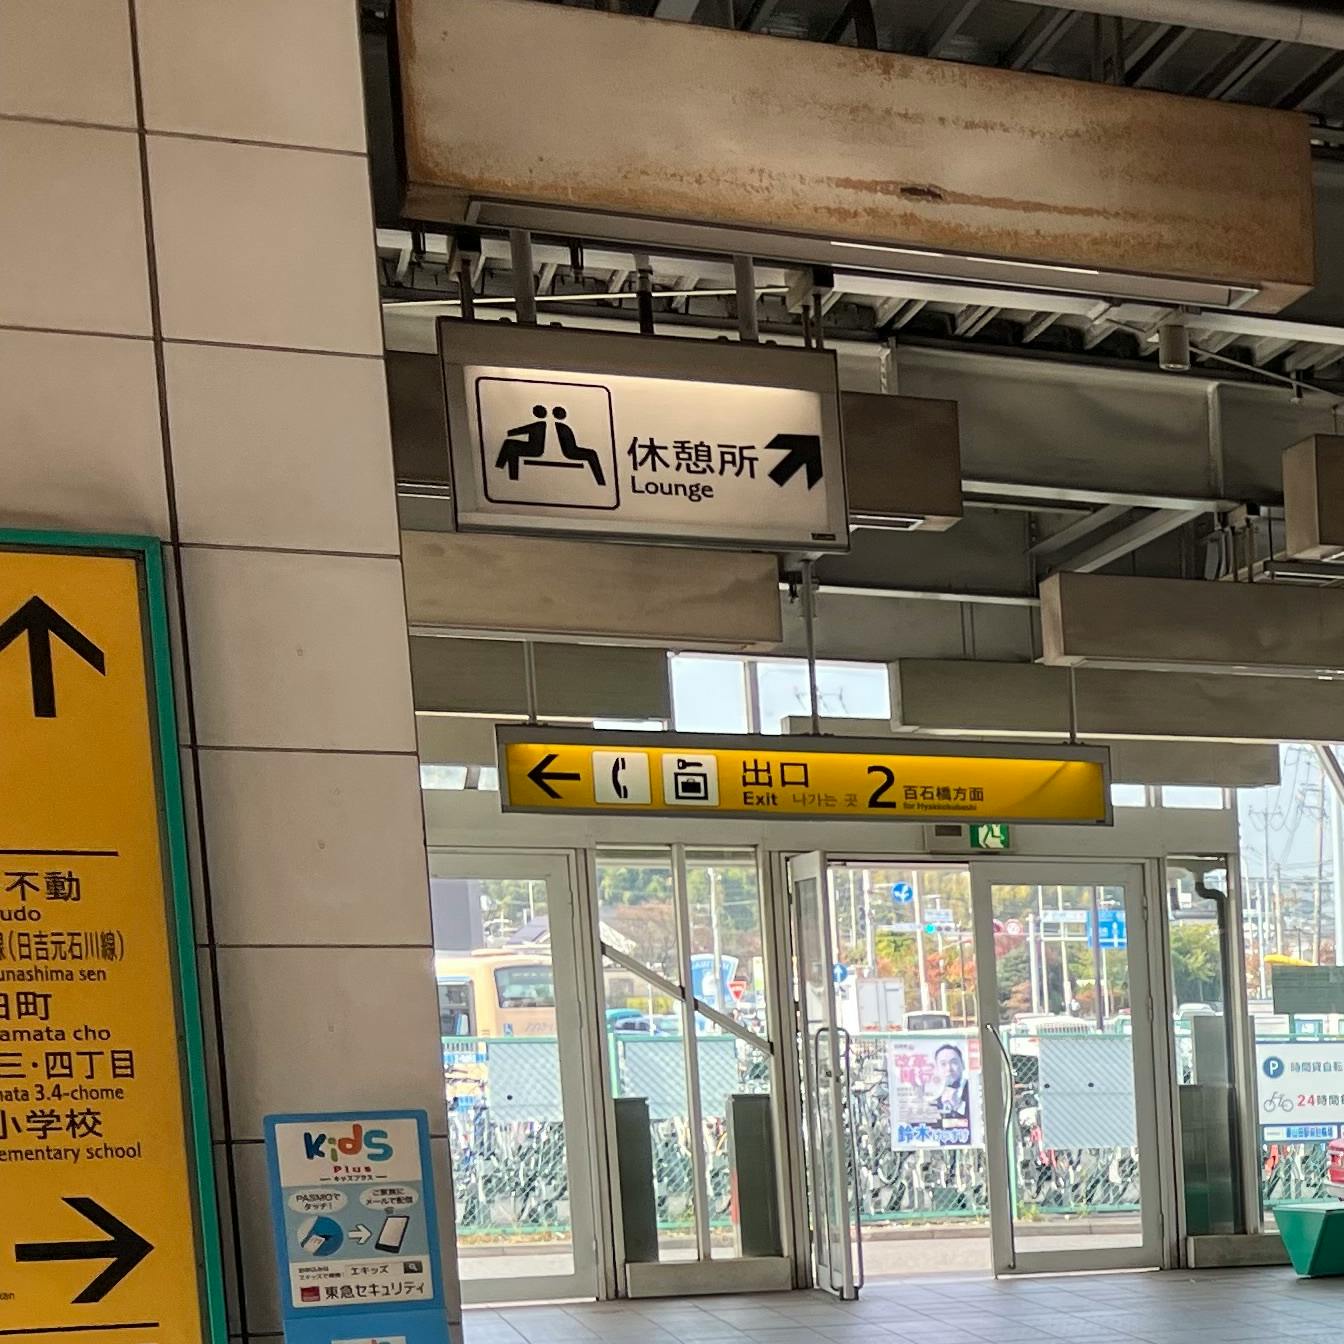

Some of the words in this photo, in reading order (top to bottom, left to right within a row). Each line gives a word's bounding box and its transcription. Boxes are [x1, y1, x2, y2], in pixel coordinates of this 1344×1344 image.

[627, 436, 758, 480] 休憩所
[631, 475, 714, 501] Lounge
[742, 759, 808, 788] 出口
[867, 765, 896, 808] 2
[903, 785, 984, 802] 百石橋方面
[743, 792, 778, 806] Exit
[4, 870, 81, 902] 不動
[0, 905, 41, 921] udo
[79, 968, 107, 981] sen
[0, 1026, 66, 1042] amata
[73, 1024, 111, 1041] cho
[0, 1086, 29, 1101] ata
[34, 1083, 124, 1101] 3.4-chome
[0, 1144, 81, 1164] ementary
[86, 1142, 142, 1160] school
[333, 1165, 372, 1174] Plus
[324, 1281, 425, 1299] 東急セキュリティ
